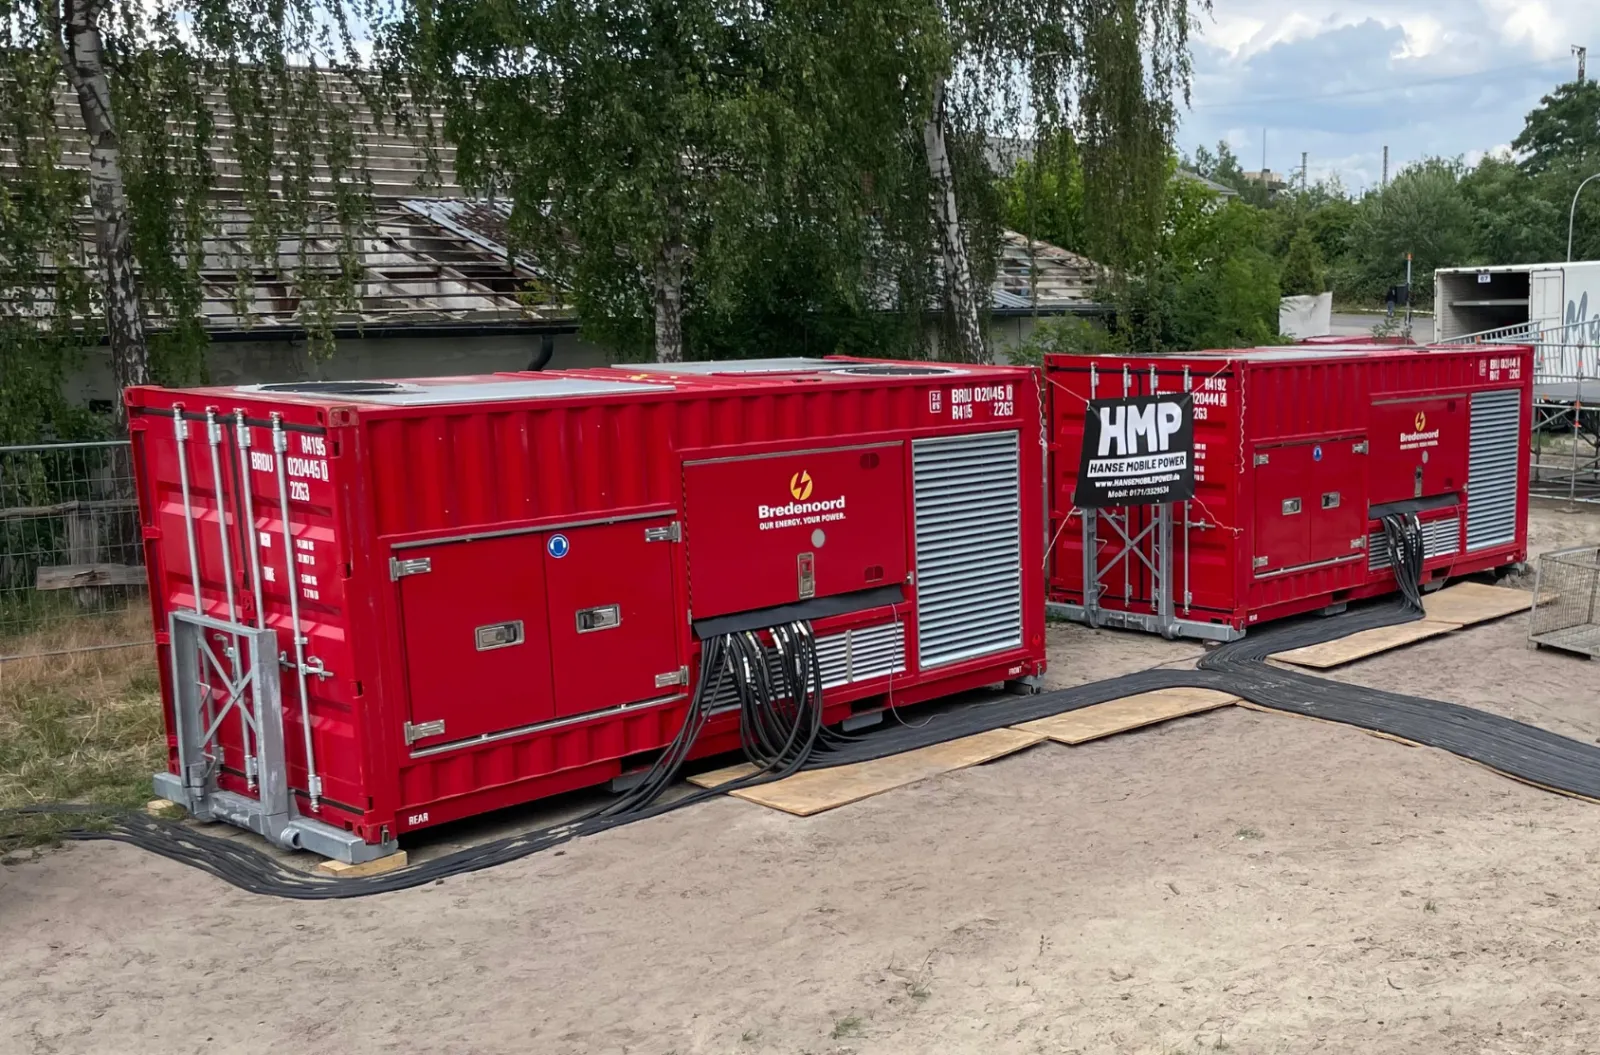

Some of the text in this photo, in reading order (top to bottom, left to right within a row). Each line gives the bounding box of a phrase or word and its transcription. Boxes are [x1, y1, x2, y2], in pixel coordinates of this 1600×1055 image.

[1205, 378, 1227, 392] R4192
[1098, 402, 1182, 456] HMP
[1400, 429, 1439, 443] Bredenoord
[301, 435, 327, 457] R4195
[251, 451, 274, 473] BRDU
[287, 457, 321, 480] 020445
[1090, 462, 1124, 474] HANSE
[1126, 459, 1157, 471] MOBILE
[1158, 455, 1185, 468] POWER
[758, 495, 846, 519] Bredenoord
[759, 522, 774, 530] OUR
[803, 515, 820, 524] YOUR
[821, 512, 846, 522] POWER.
[408, 812, 429, 826] REAR
